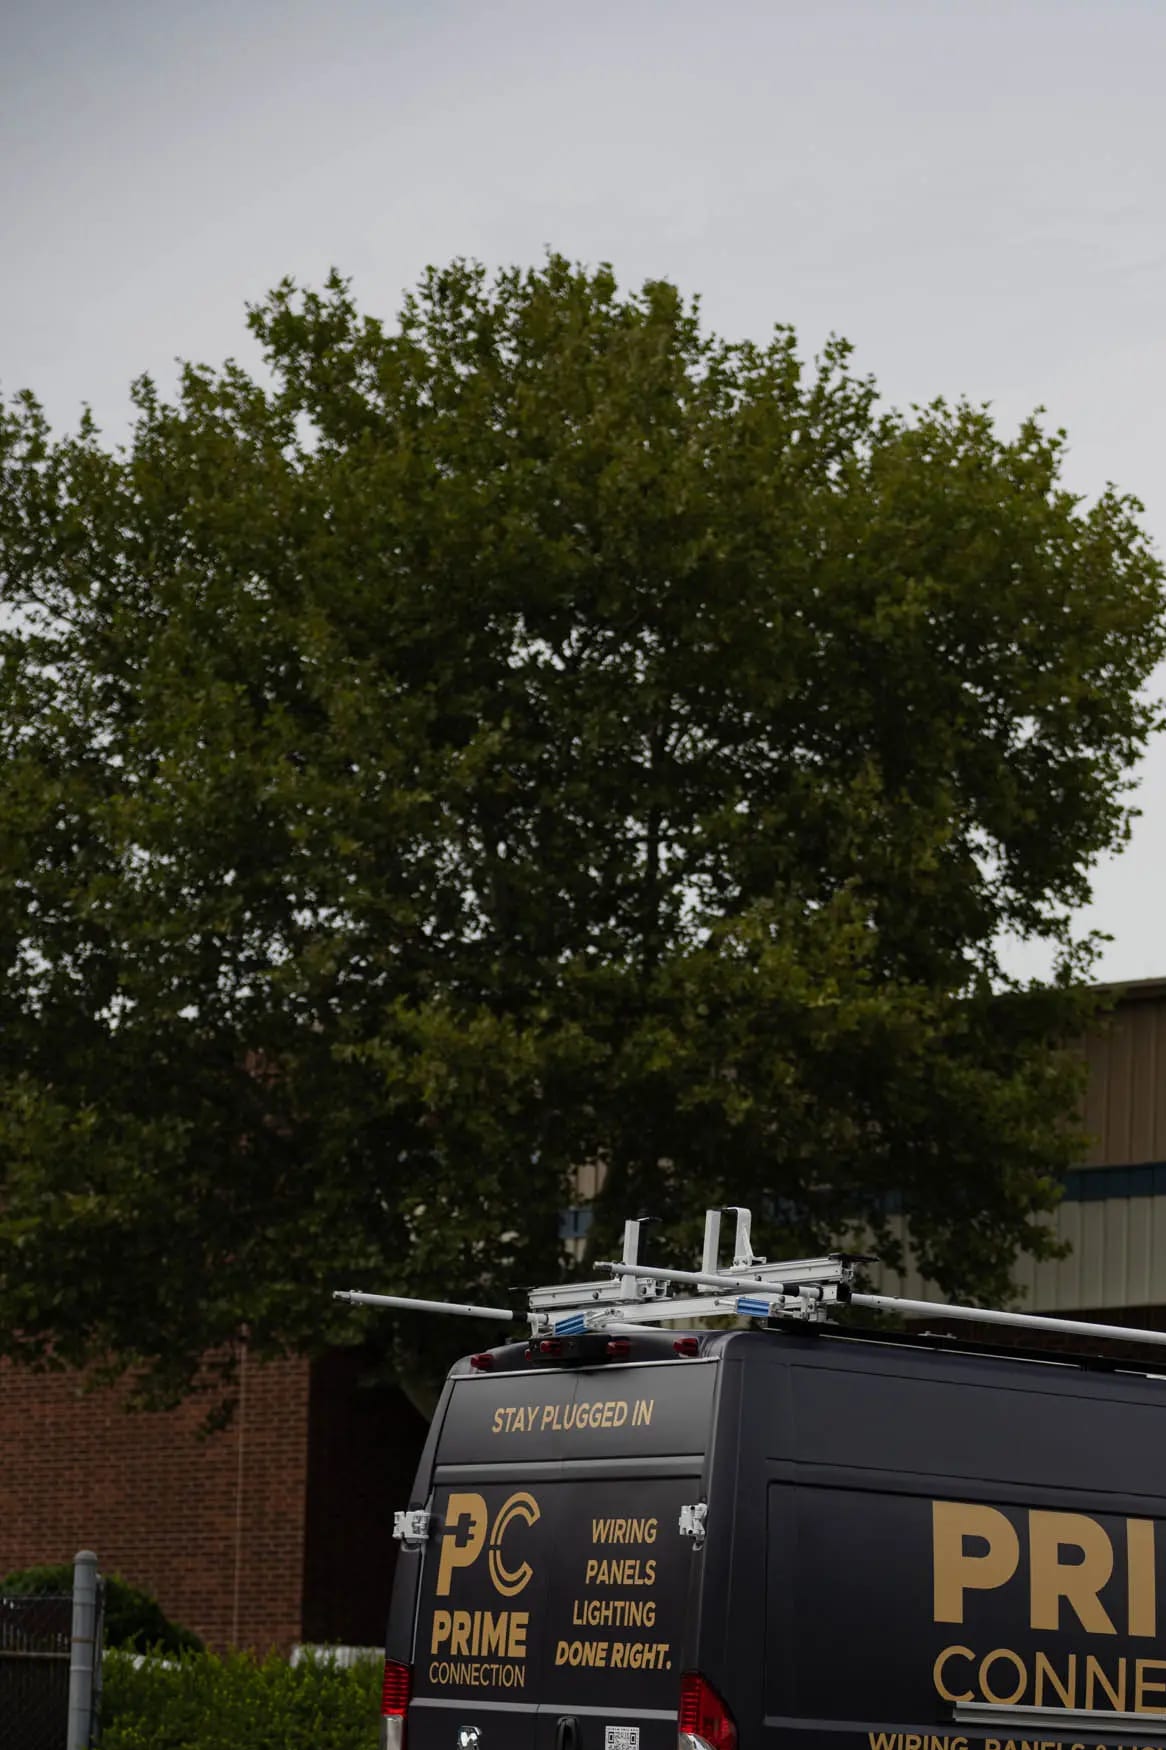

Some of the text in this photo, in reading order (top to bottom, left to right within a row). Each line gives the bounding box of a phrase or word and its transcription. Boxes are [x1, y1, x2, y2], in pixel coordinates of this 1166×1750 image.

[491, 1400, 654, 1433] STAY PLUGGED IN
[435, 1492, 541, 1597] PC
[592, 1518, 658, 1544] WIRING
[586, 1560, 656, 1585] PANELS
[572, 1600, 656, 1627] LIGHTING
[431, 1610, 529, 1657] PRIME
[555, 1641, 672, 1670] DONE RIGHT.
[429, 1662, 526, 1687] CONNECTION
